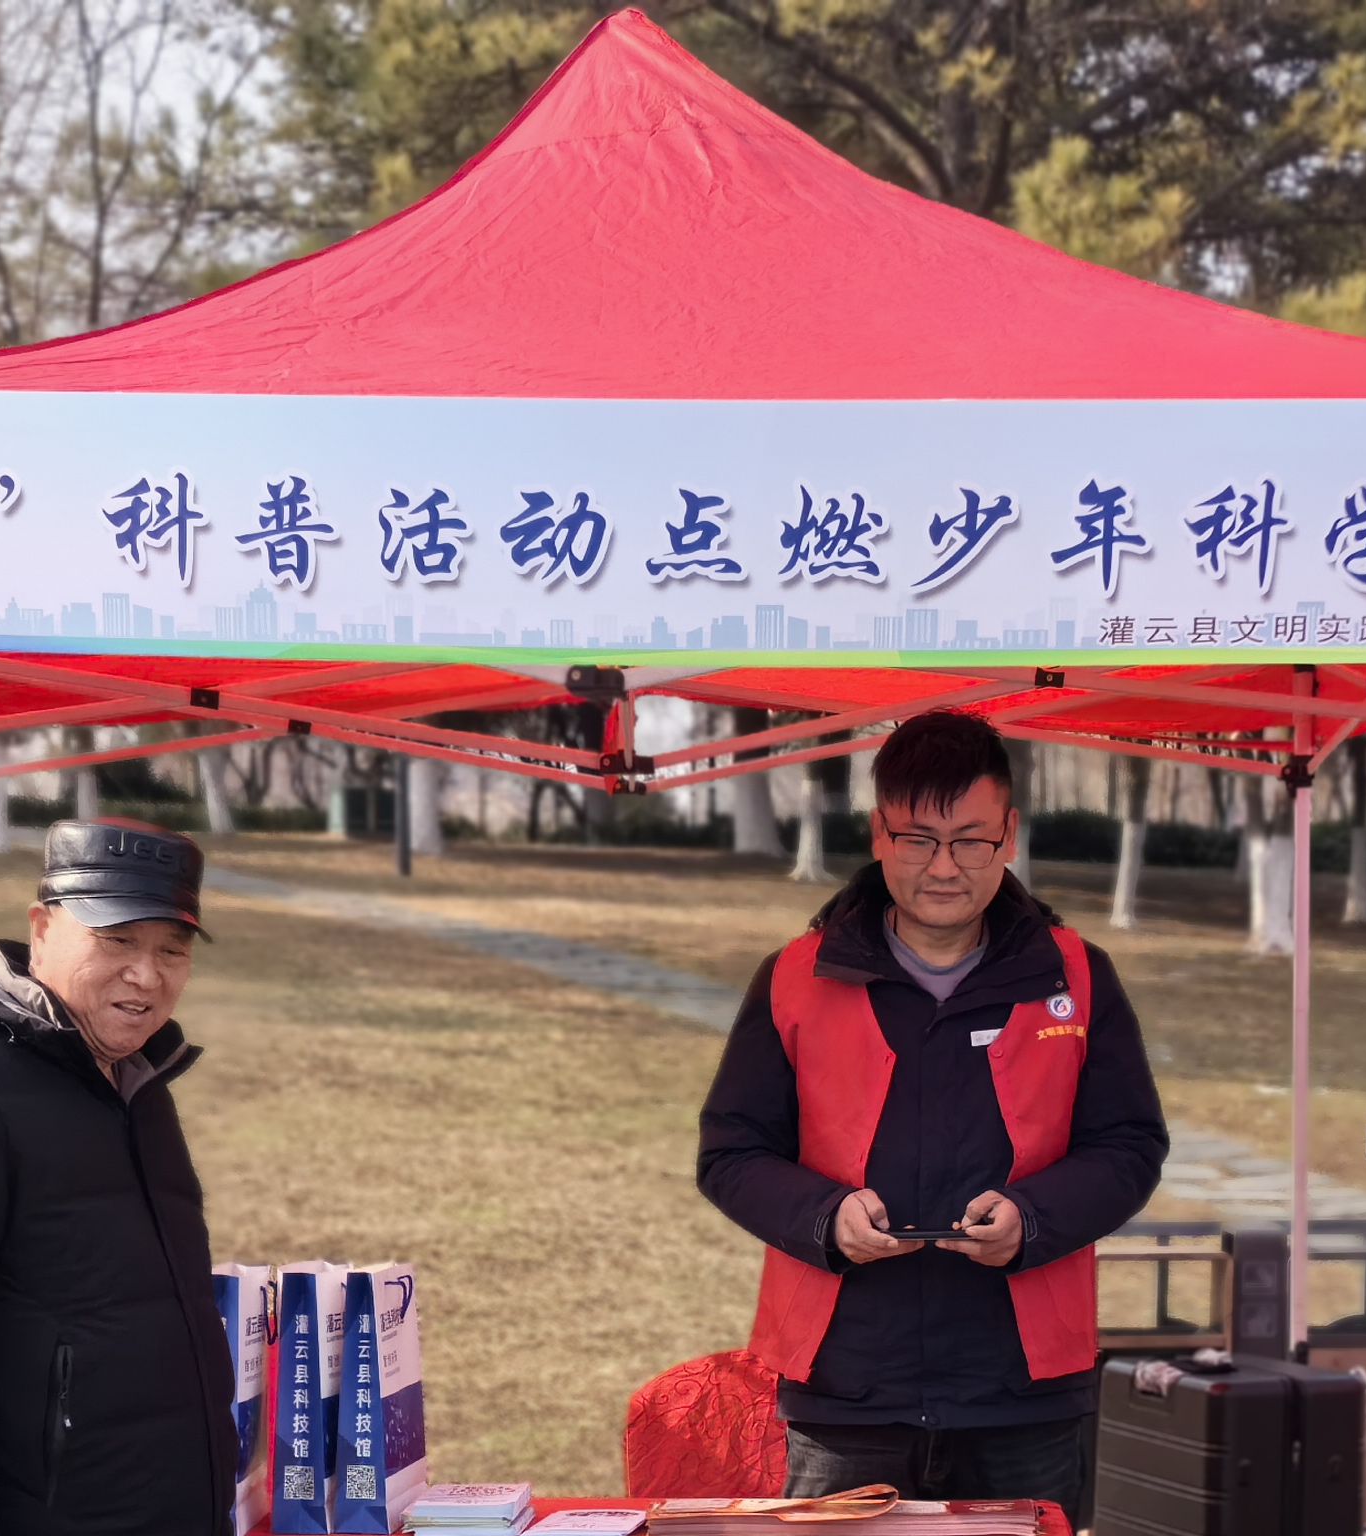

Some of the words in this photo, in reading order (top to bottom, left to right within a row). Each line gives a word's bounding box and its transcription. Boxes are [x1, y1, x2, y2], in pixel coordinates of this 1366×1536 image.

[293, 1314, 309, 1458] 灌云县科技馆
[355, 1314, 372, 1458] 灌云县科技馆
